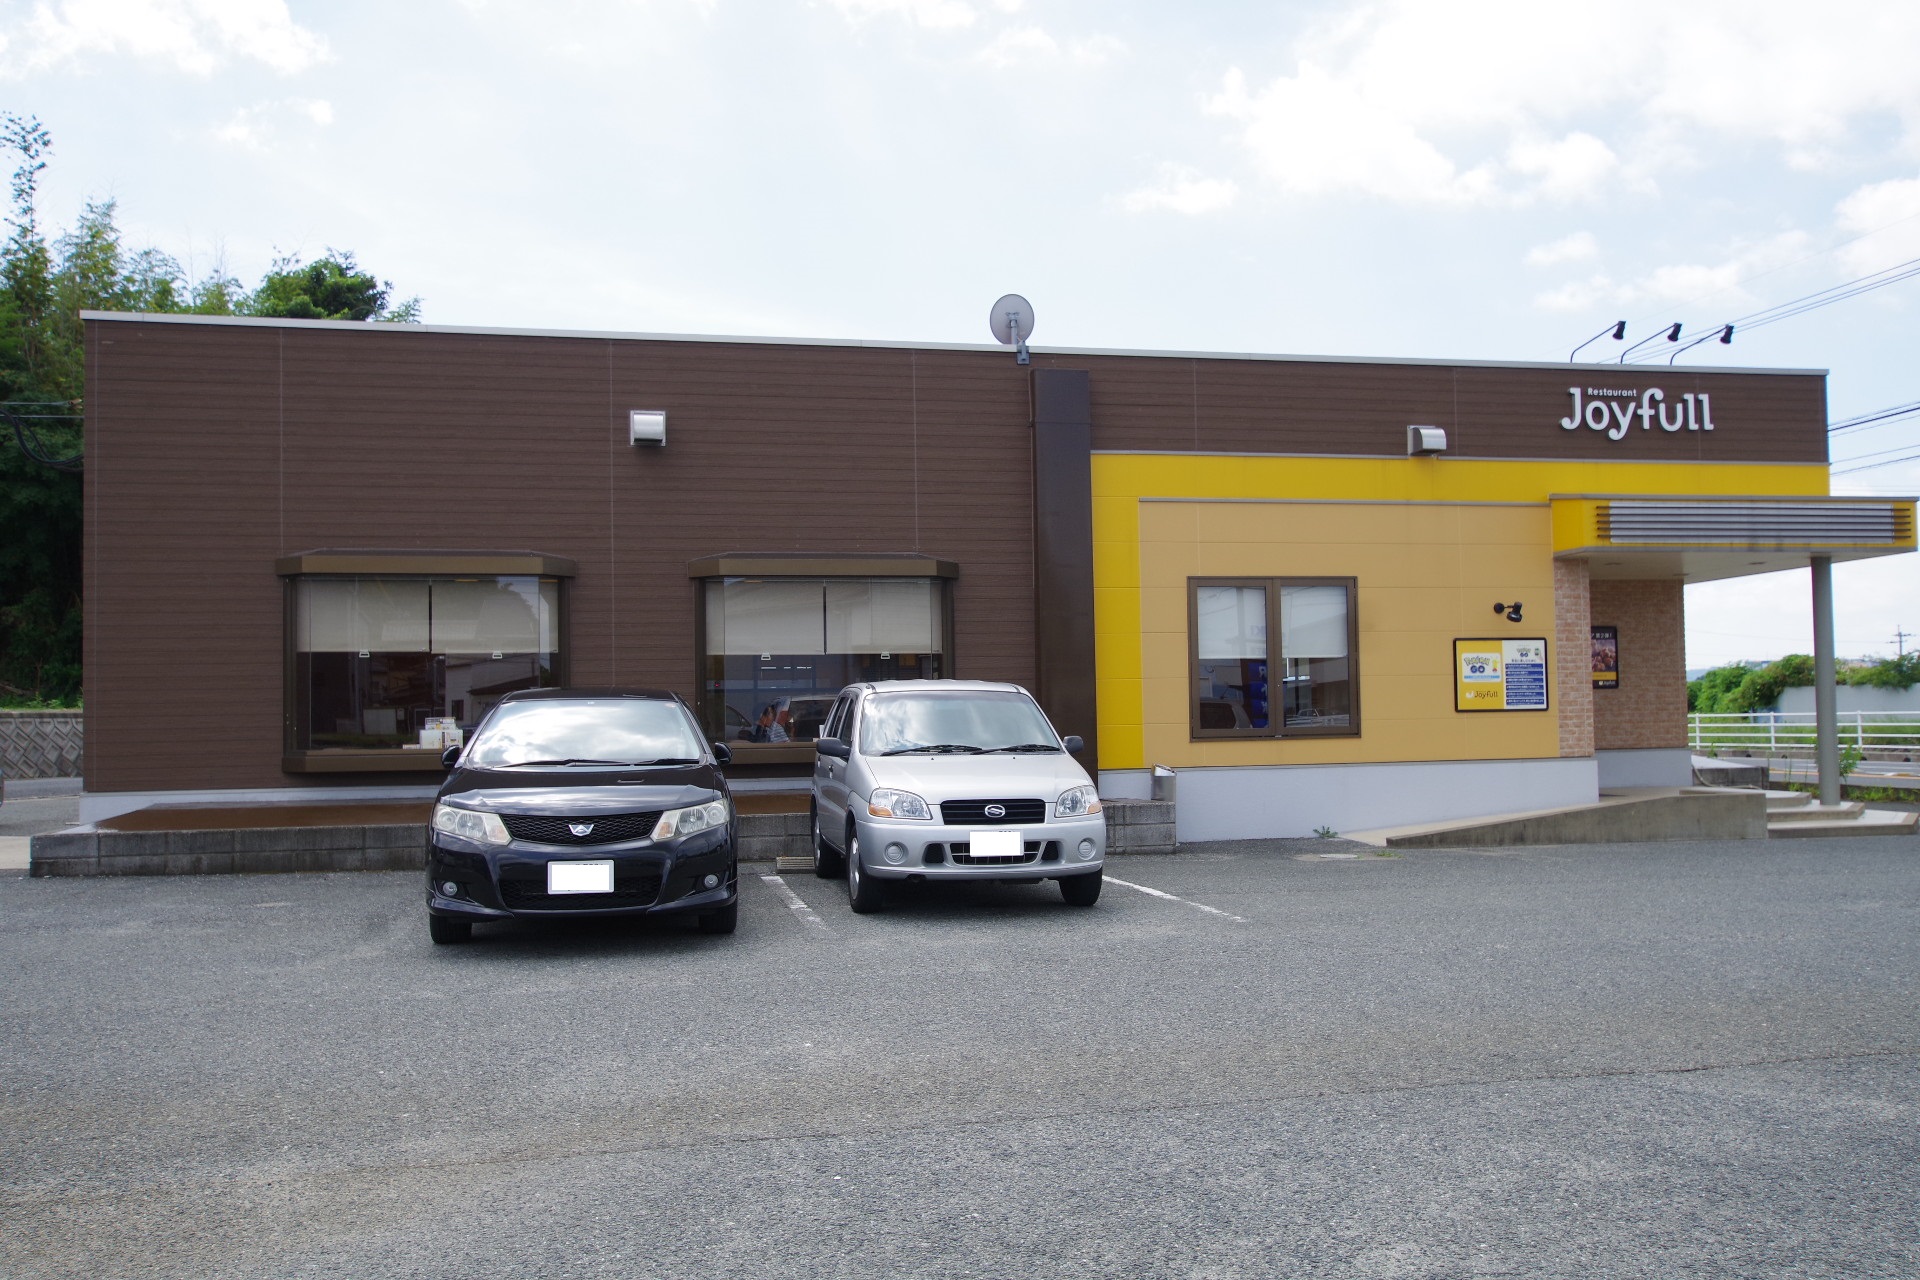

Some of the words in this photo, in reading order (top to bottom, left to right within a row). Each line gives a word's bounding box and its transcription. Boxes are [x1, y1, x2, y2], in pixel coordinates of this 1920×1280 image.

[1587, 387, 1637, 397] Restaurant
[1559, 386, 1715, 441] Joyfull
[1470, 665, 1485, 674] GO
[1474, 690, 1498, 700] Joyfull
